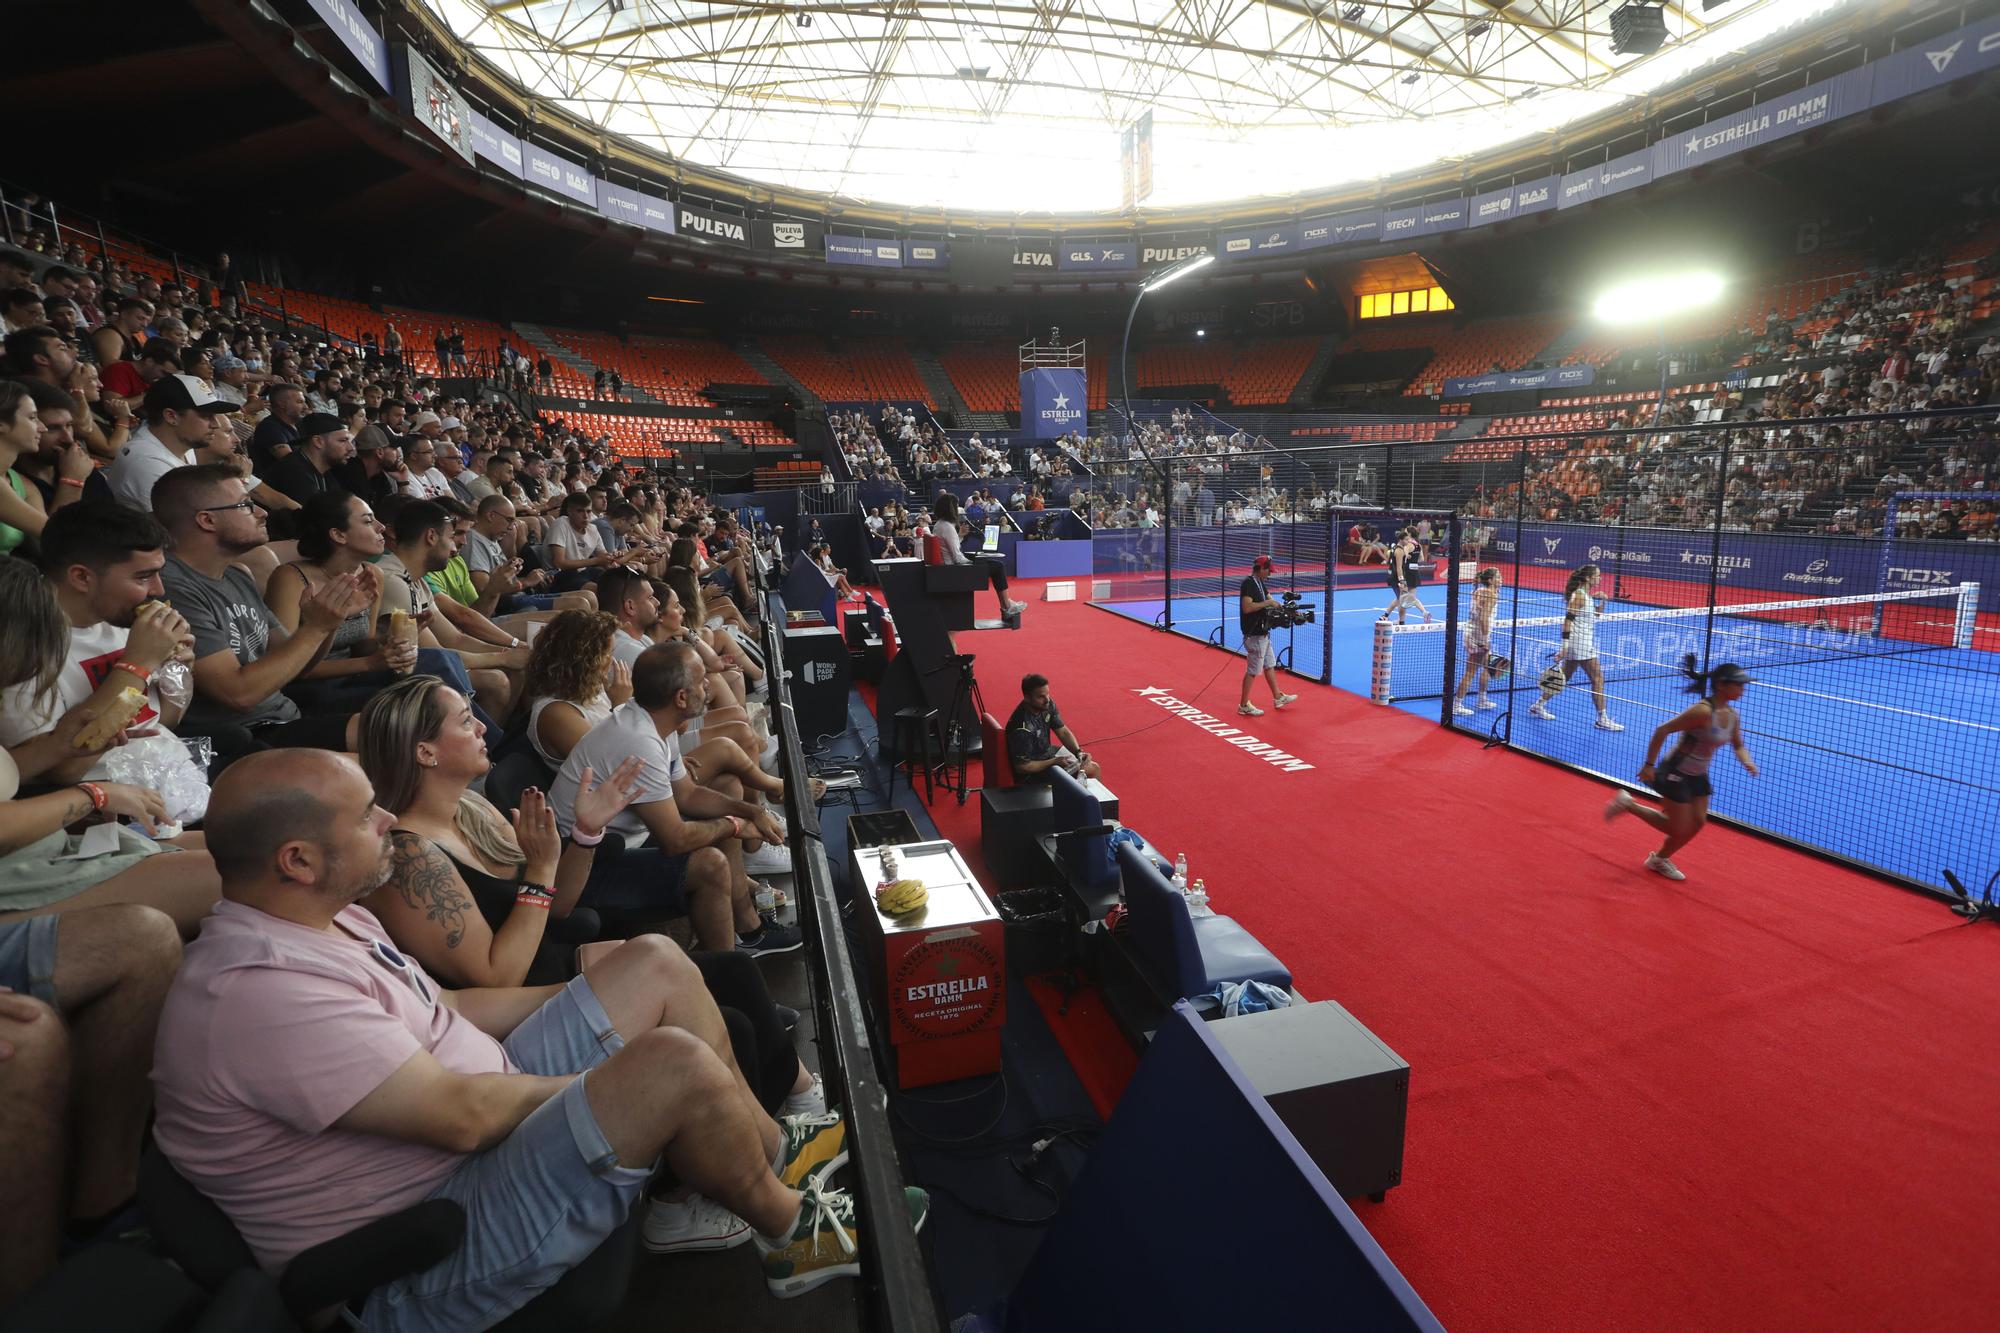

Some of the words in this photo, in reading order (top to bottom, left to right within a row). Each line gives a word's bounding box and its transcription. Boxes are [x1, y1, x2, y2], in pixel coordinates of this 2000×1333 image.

[1703, 114, 1770, 150] ESTRELLA
[1776, 94, 1828, 125] DAMM
[1424, 211, 1460, 223] HEAD
[681, 210, 745, 241] PULEVA
[775, 225, 802, 235] PULEVA
[1041, 410, 1081, 419] ESTRELLA
[816, 673, 834, 681] TOUR
[1147, 695, 1244, 737] ESTRELLA
[1223, 735, 1317, 772] DAMM
[907, 975, 989, 1001] ESTRELLA
[934, 993, 963, 1005] DAMM
[914, 1009, 946, 1019] RECETA
[946, 1003, 983, 1014] ORIGINAL
